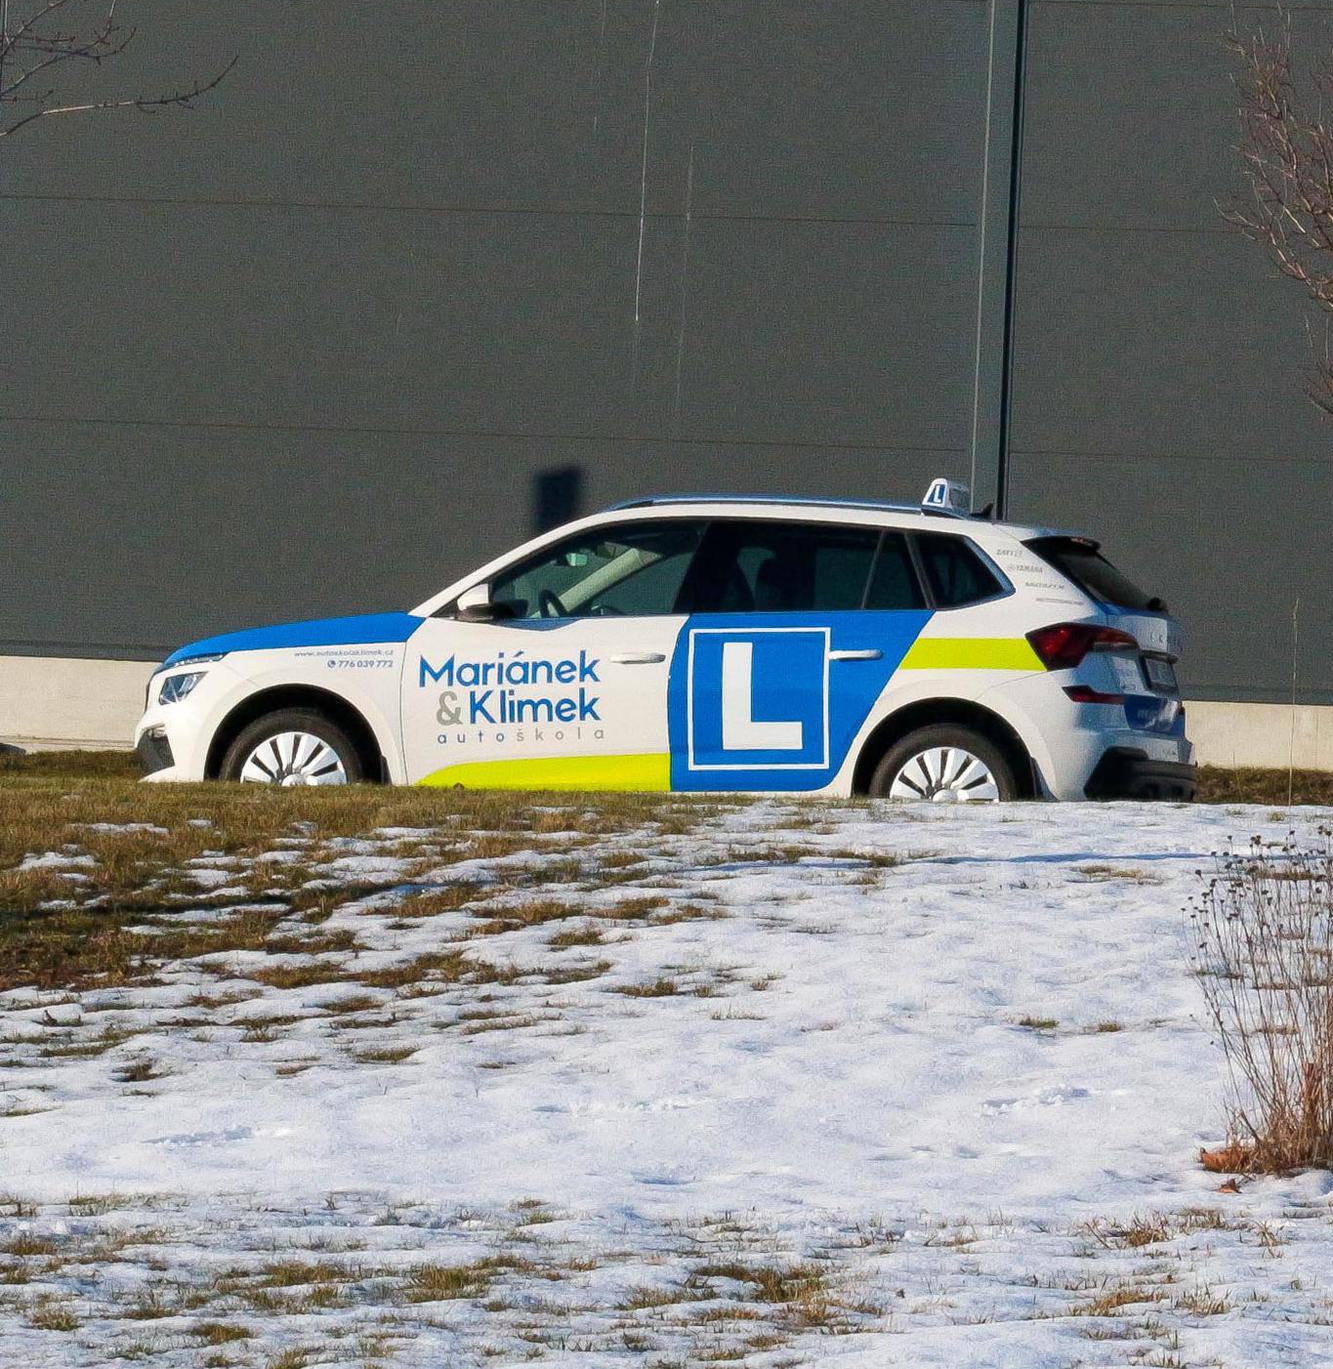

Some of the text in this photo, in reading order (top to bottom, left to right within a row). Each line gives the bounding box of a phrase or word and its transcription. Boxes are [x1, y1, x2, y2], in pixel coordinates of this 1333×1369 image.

[932, 484, 942, 503] L
[338, 659, 394, 668] 776 039 772
[419, 650, 601, 687] Mariánek
[436, 687, 601, 726] & Klimek
[723, 643, 802, 749] L
[437, 727, 605, 744] autoškola
